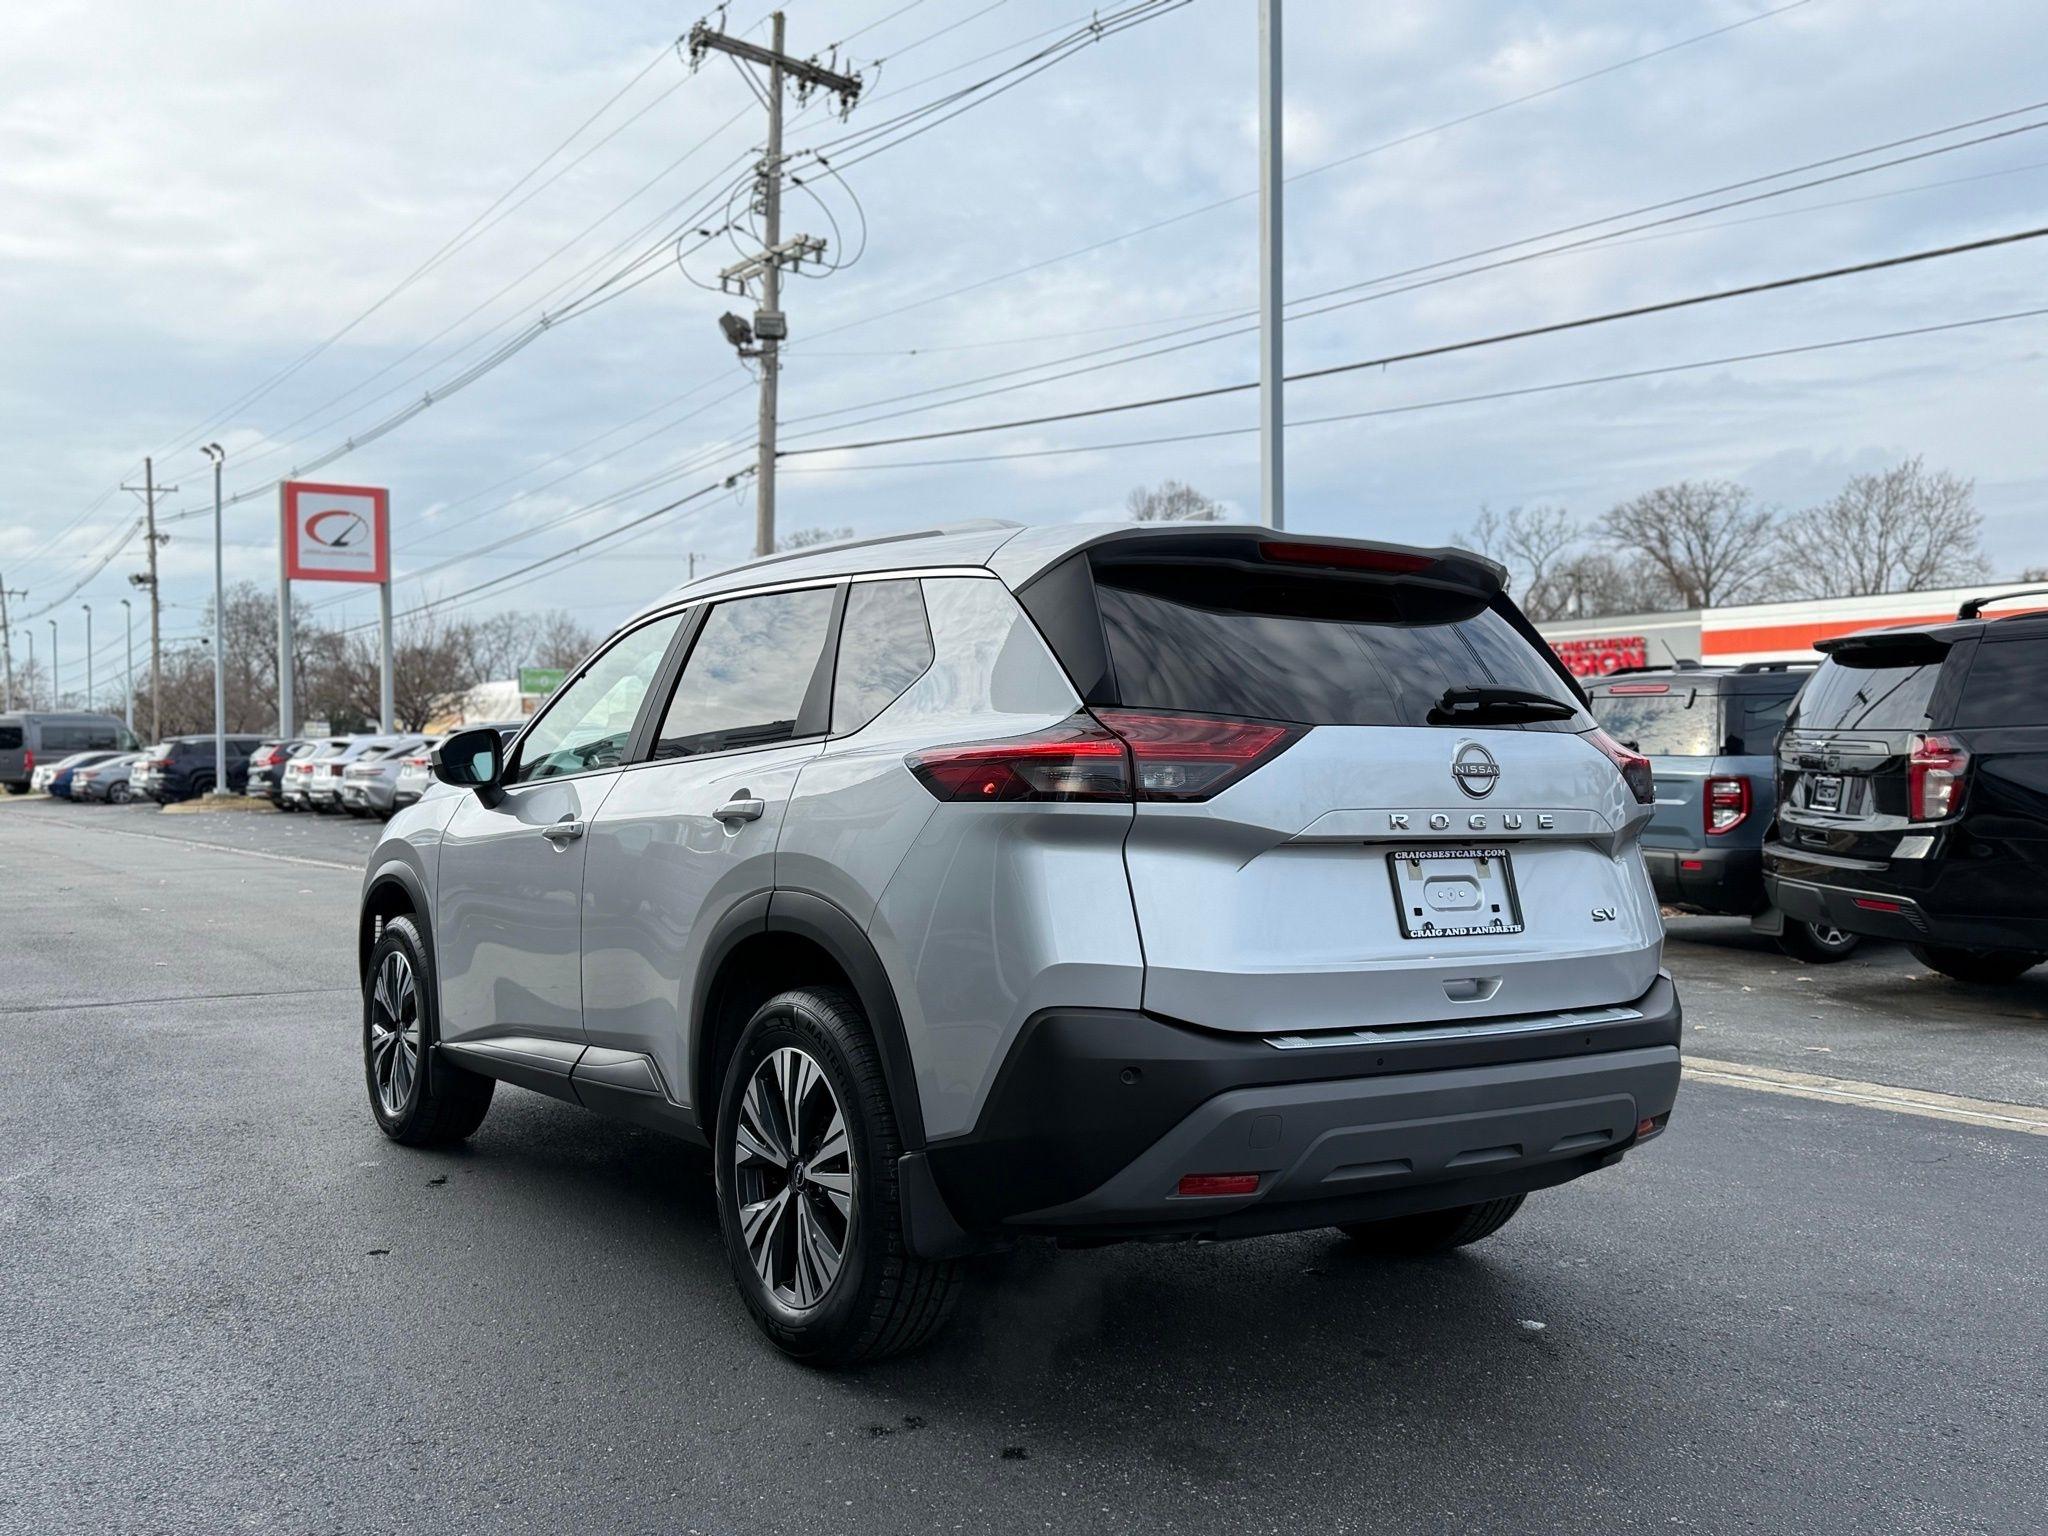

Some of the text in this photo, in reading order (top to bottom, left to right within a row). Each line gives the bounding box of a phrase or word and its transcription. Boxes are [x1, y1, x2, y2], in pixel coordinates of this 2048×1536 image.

[1455, 764, 1500, 776] NISSAN
[1388, 813, 1555, 830] ROGUE
[1395, 849, 1506, 860] CRAIGSBESTCARS.COM
[1591, 907, 1617, 923] SV
[1410, 924, 1522, 938] CRAIG AND LANDRETH
